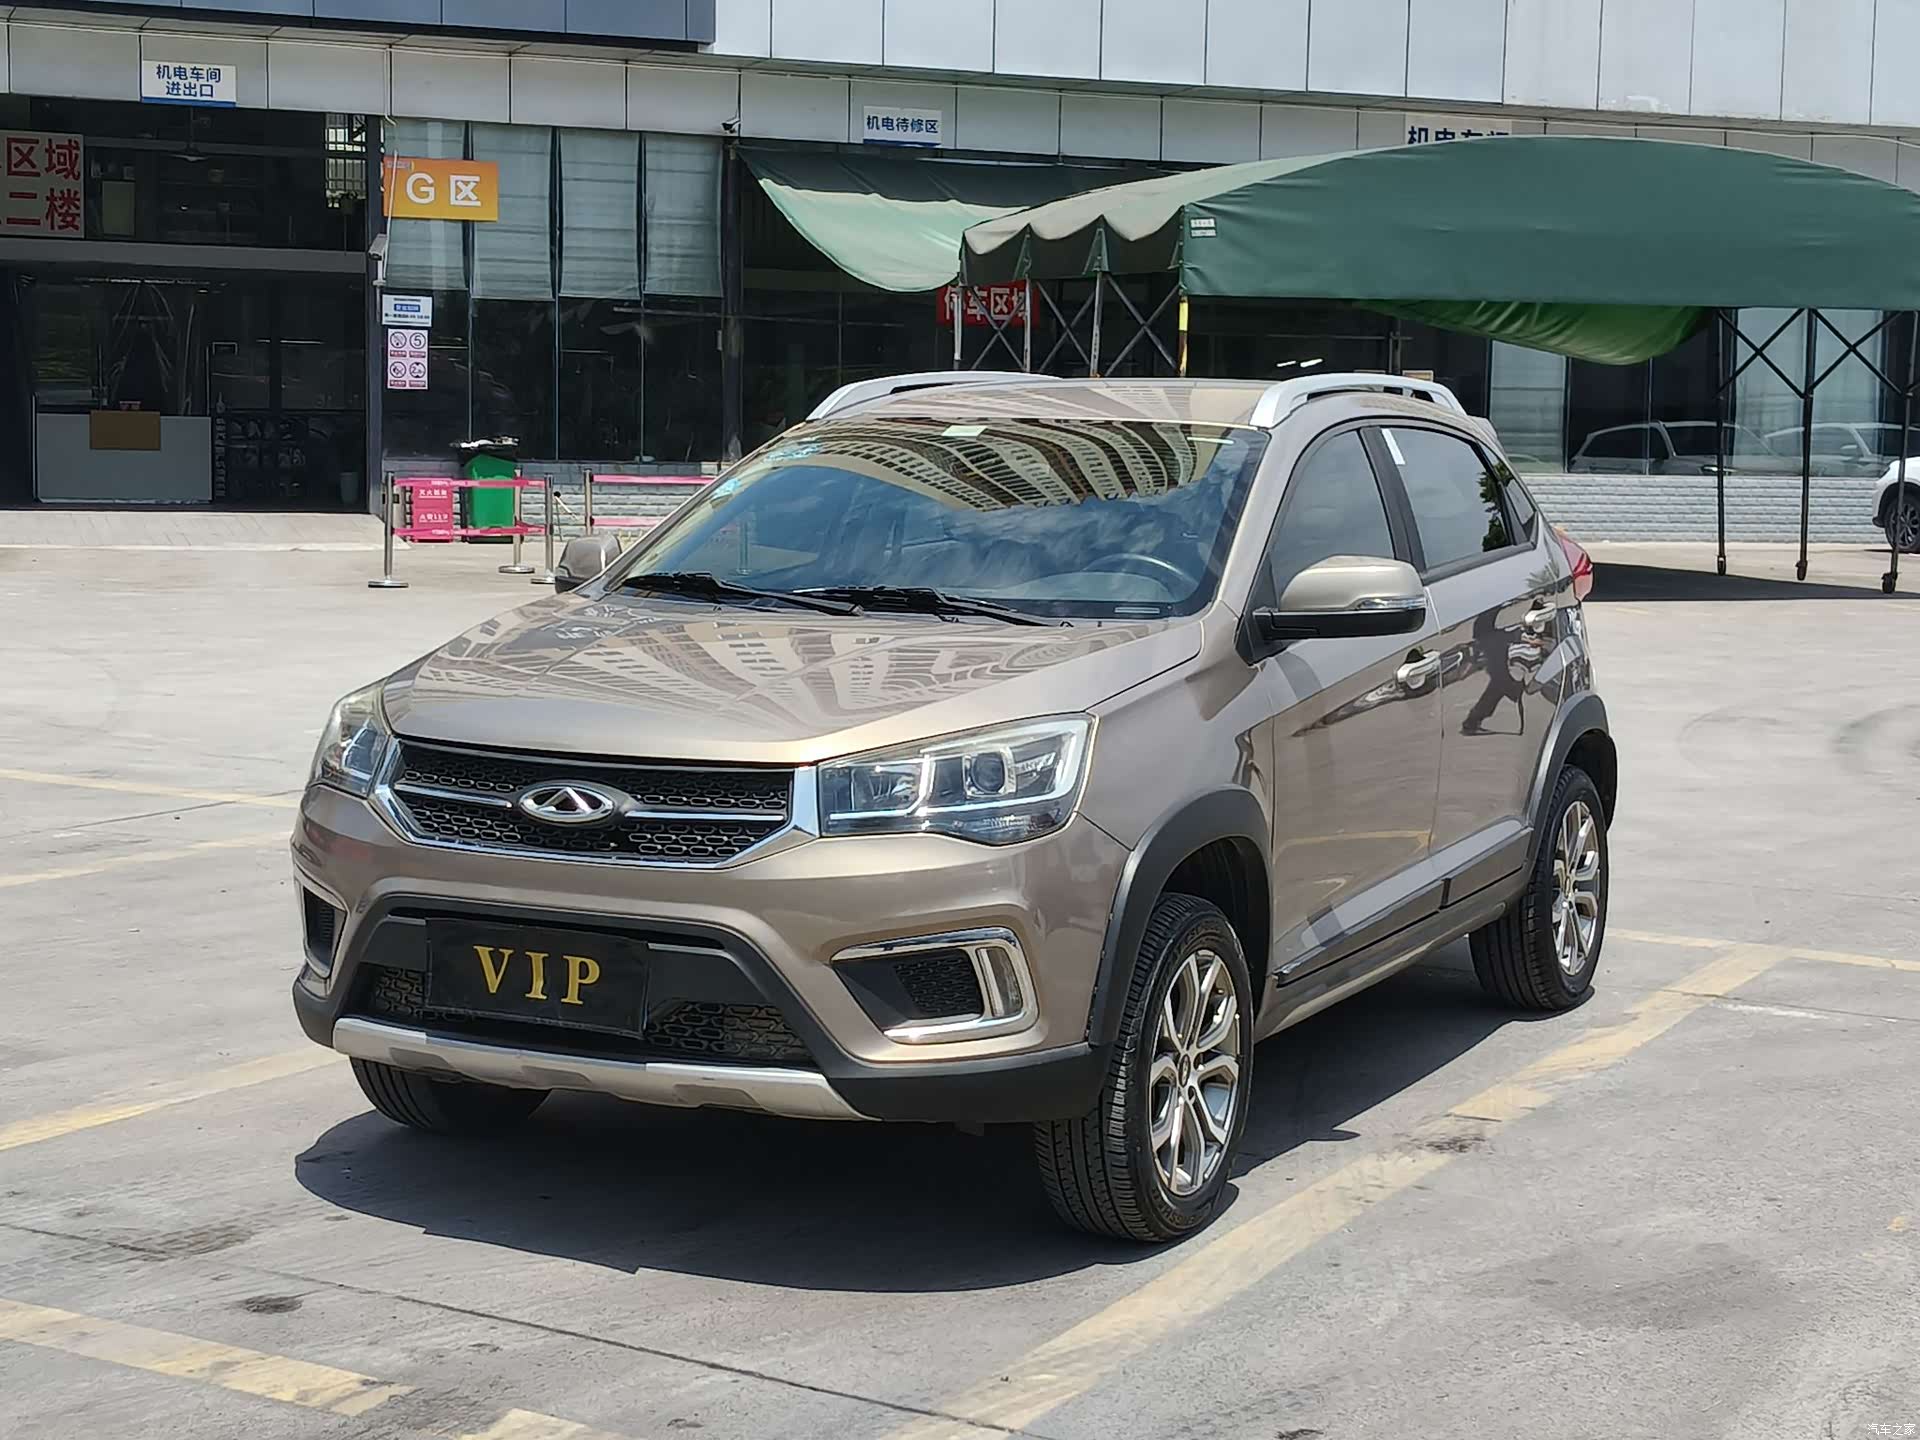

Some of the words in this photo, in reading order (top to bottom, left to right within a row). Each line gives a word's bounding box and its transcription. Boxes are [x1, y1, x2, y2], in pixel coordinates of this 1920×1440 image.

[156, 64, 221, 83] 机电车间
[166, 81, 214, 98] 进出口
[866, 115, 938, 133] 机电待修区
[1408, 126, 1509, 144] 机电
[0, 137, 80, 180] 区域
[0, 187, 80, 230] 二楼
[473, 946, 600, 1005] VIP
